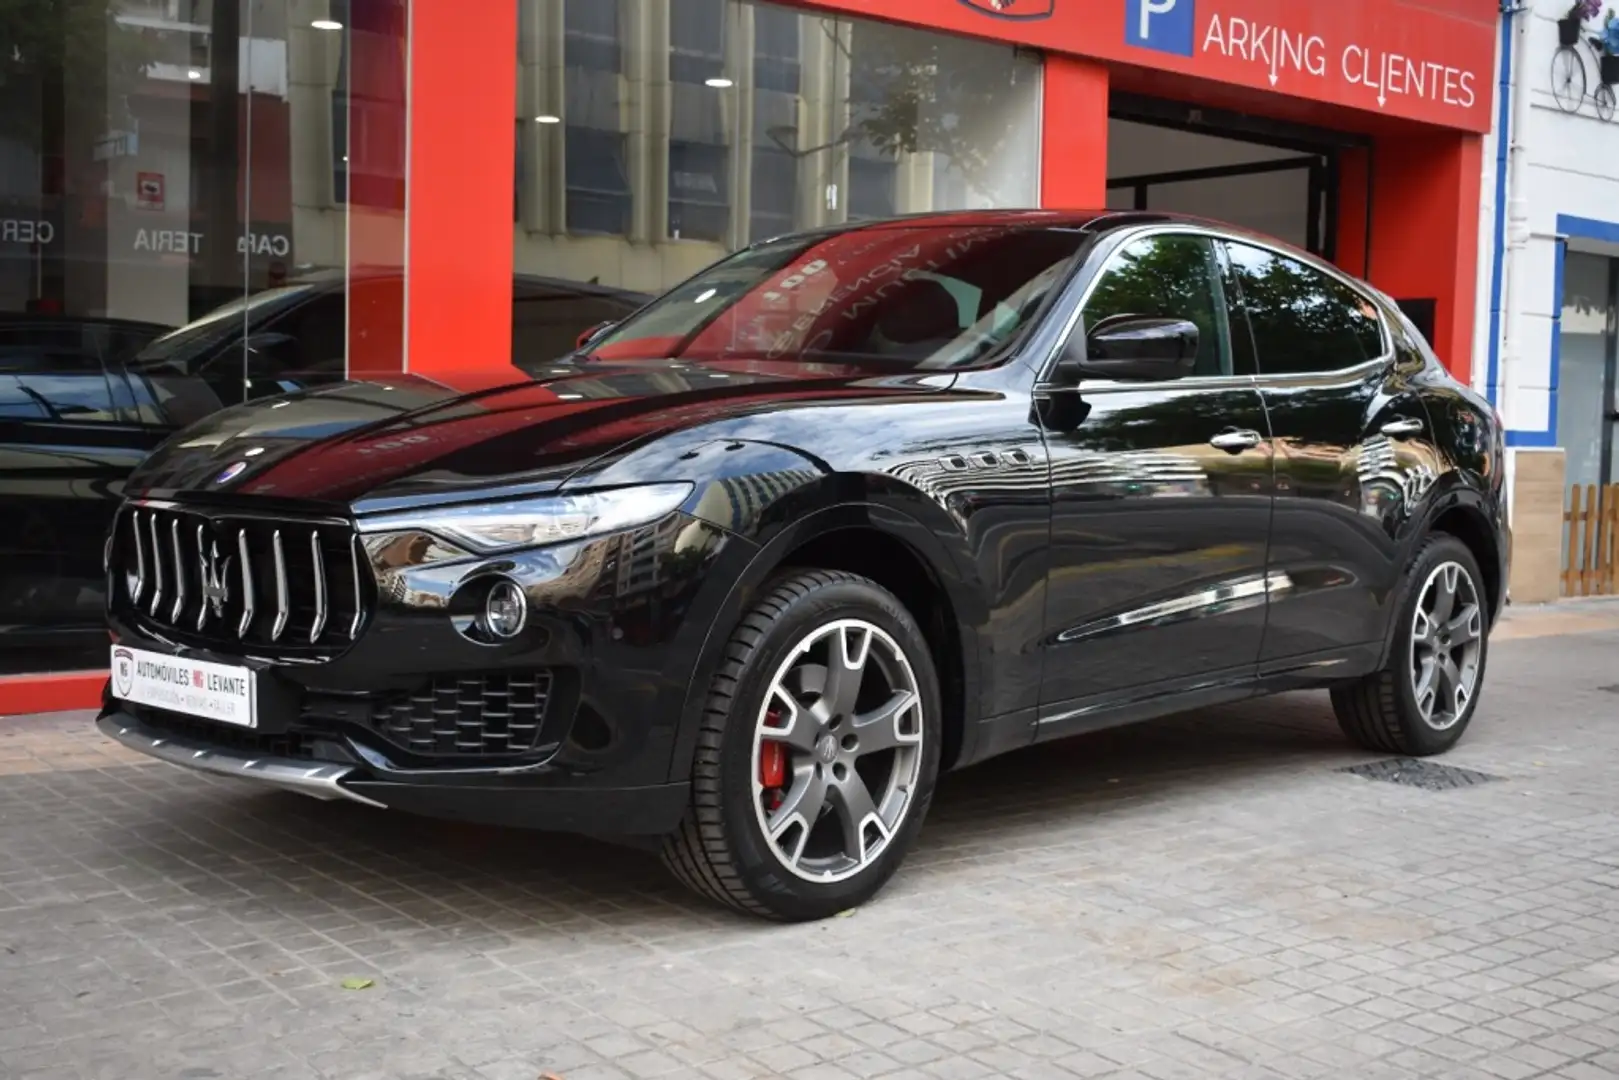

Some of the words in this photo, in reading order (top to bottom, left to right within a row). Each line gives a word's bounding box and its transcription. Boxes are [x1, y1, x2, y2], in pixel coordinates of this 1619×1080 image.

[1139, 0, 1176, 39] P
[1342, 44, 1475, 107] CLIENTES
[136, 661, 189, 686] AUTOMÓVILES
[207, 675, 246, 697] LEVANTE
